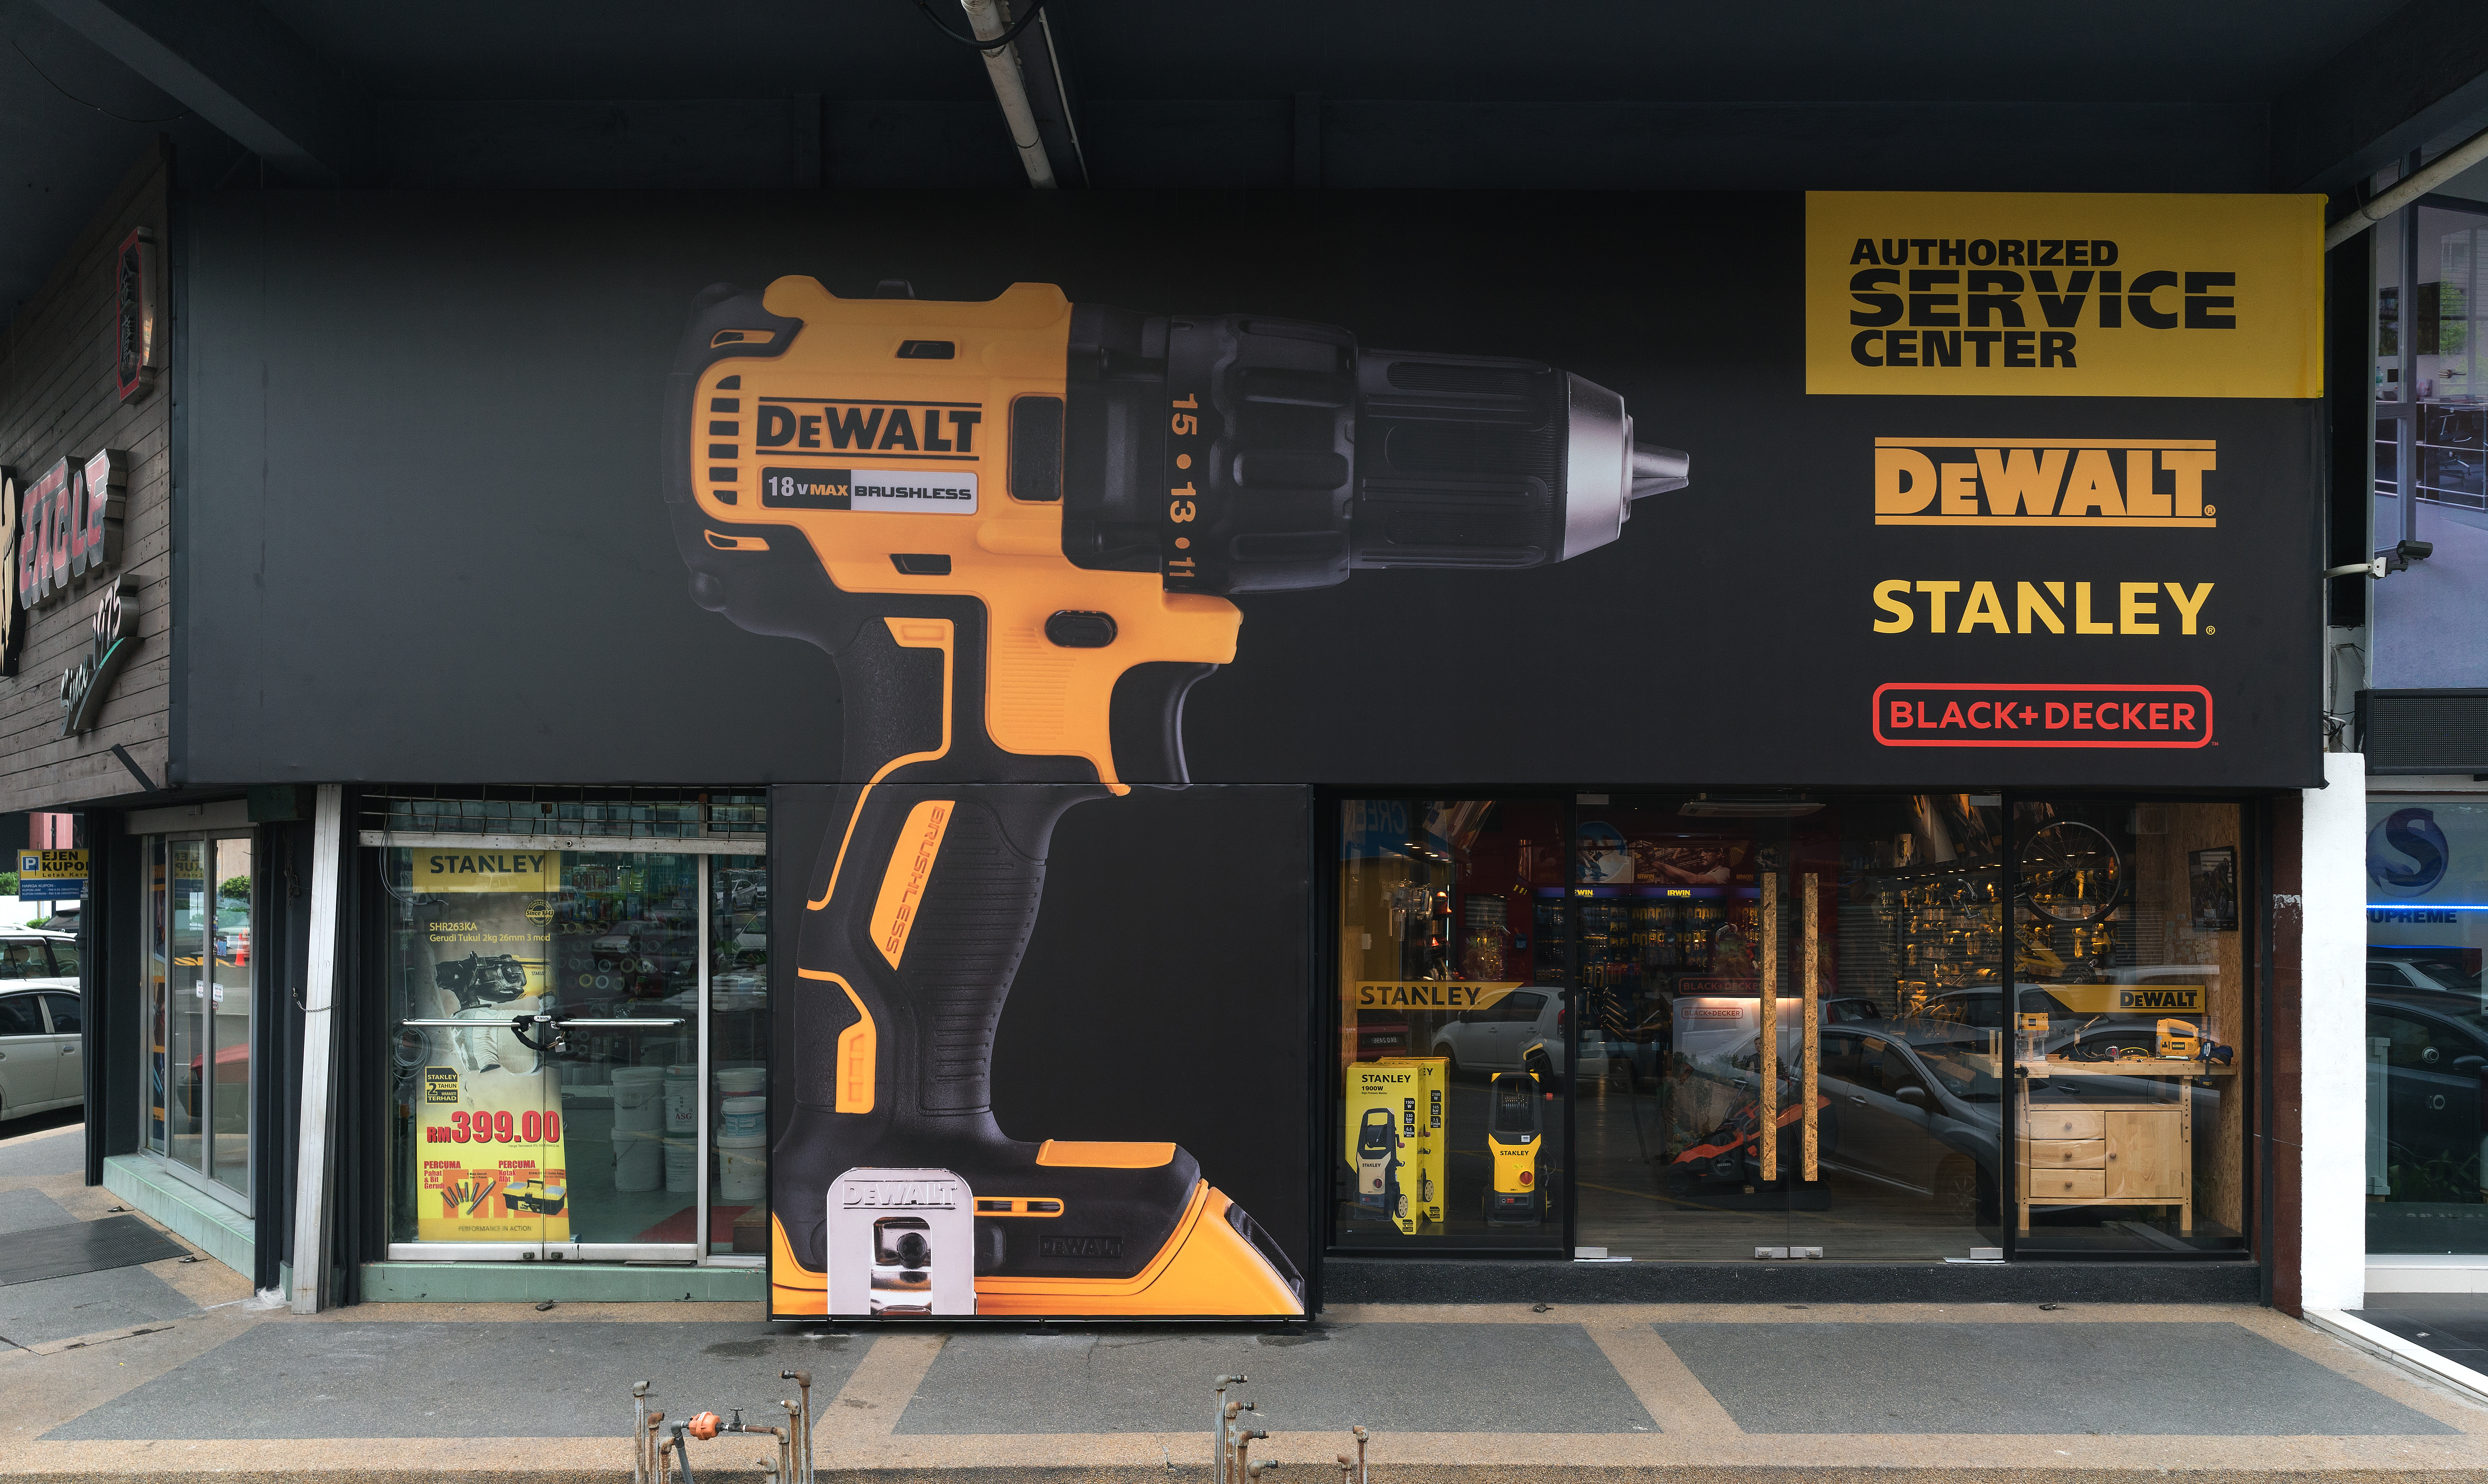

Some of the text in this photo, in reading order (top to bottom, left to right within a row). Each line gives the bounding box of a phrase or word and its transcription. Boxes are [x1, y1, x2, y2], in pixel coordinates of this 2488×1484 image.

[1850, 238, 2119, 266] AUTHORIZED
[1850, 268, 2236, 329] SERVICE
[1850, 329, 2077, 368] CENTER
[1171, 393, 1198, 435] 15
[756, 404, 982, 453] DEWALT
[854, 485, 971, 500] BRUSHLESS
[1875, 448, 2216, 517] DEWALT
[1170, 481, 1196, 523] 13
[19, 448, 110, 610] EAGLE
[1169, 557, 1195, 577] 11
[1873, 579, 2215, 635] STANLEY
[93, 574, 121, 670] 1975
[1891, 701, 2196, 730] BLACK+DECKER
[26, 857, 36, 869] P
[42, 851, 78, 861] EJEN
[430, 855, 544, 873] STANLEY
[885, 806, 945, 954] BRUSHLESS
[2367, 909, 2457, 923] UPREME
[430, 922, 477, 931] SHR263KA
[483, 934, 497, 943] 2kg
[1360, 986, 1482, 1006] STANLEY
[1684, 982, 1760, 990] BLACK+DECKE
[2120, 991, 2197, 1007] DEWALT
[428, 1082, 438, 1095] 2
[1362, 1074, 1411, 1083] STANLEY
[424, 1160, 461, 1169] PERCUMA
[499, 1160, 536, 1168] PERCUMA
